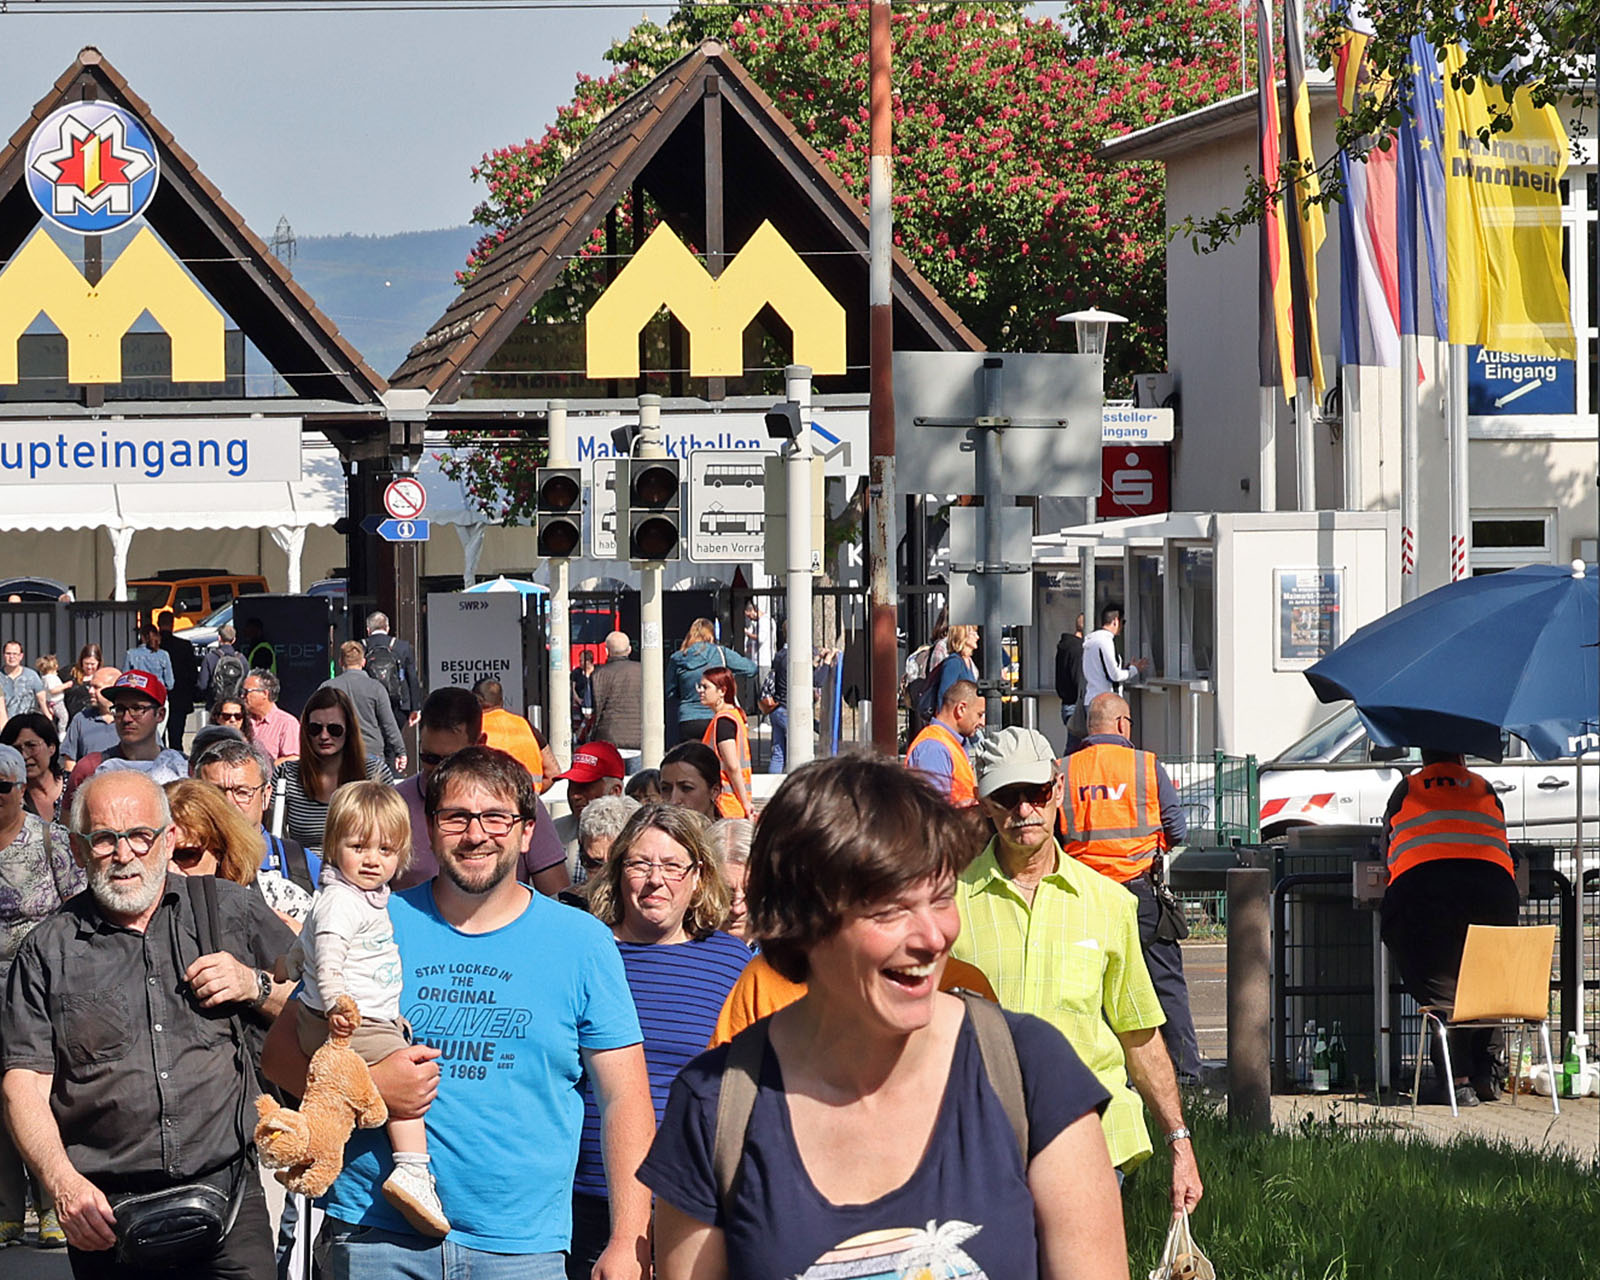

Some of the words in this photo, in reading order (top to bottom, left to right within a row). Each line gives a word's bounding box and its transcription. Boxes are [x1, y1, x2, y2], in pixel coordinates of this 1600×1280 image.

[1485, 364, 1556, 383] Eingang
[1103, 411, 1158, 423] ssteller-
[1103, 425, 1148, 438] ingang
[697, 541, 728, 553] haben
[441, 660, 510, 672] BESUCHEN
[451, 673, 469, 684] SIE
[1423, 776, 1472, 789] rnv
[1079, 783, 1127, 802] rnv
[415, 964, 446, 978] STAY
[449, 963, 498, 977] LOCKED
[498, 970, 513, 982] IN
[451, 976, 474, 987] THE
[417, 986, 497, 1004] ORIGINAL
[403, 1002, 533, 1039] OLIVER
[450, 1063, 487, 1080] 1969
